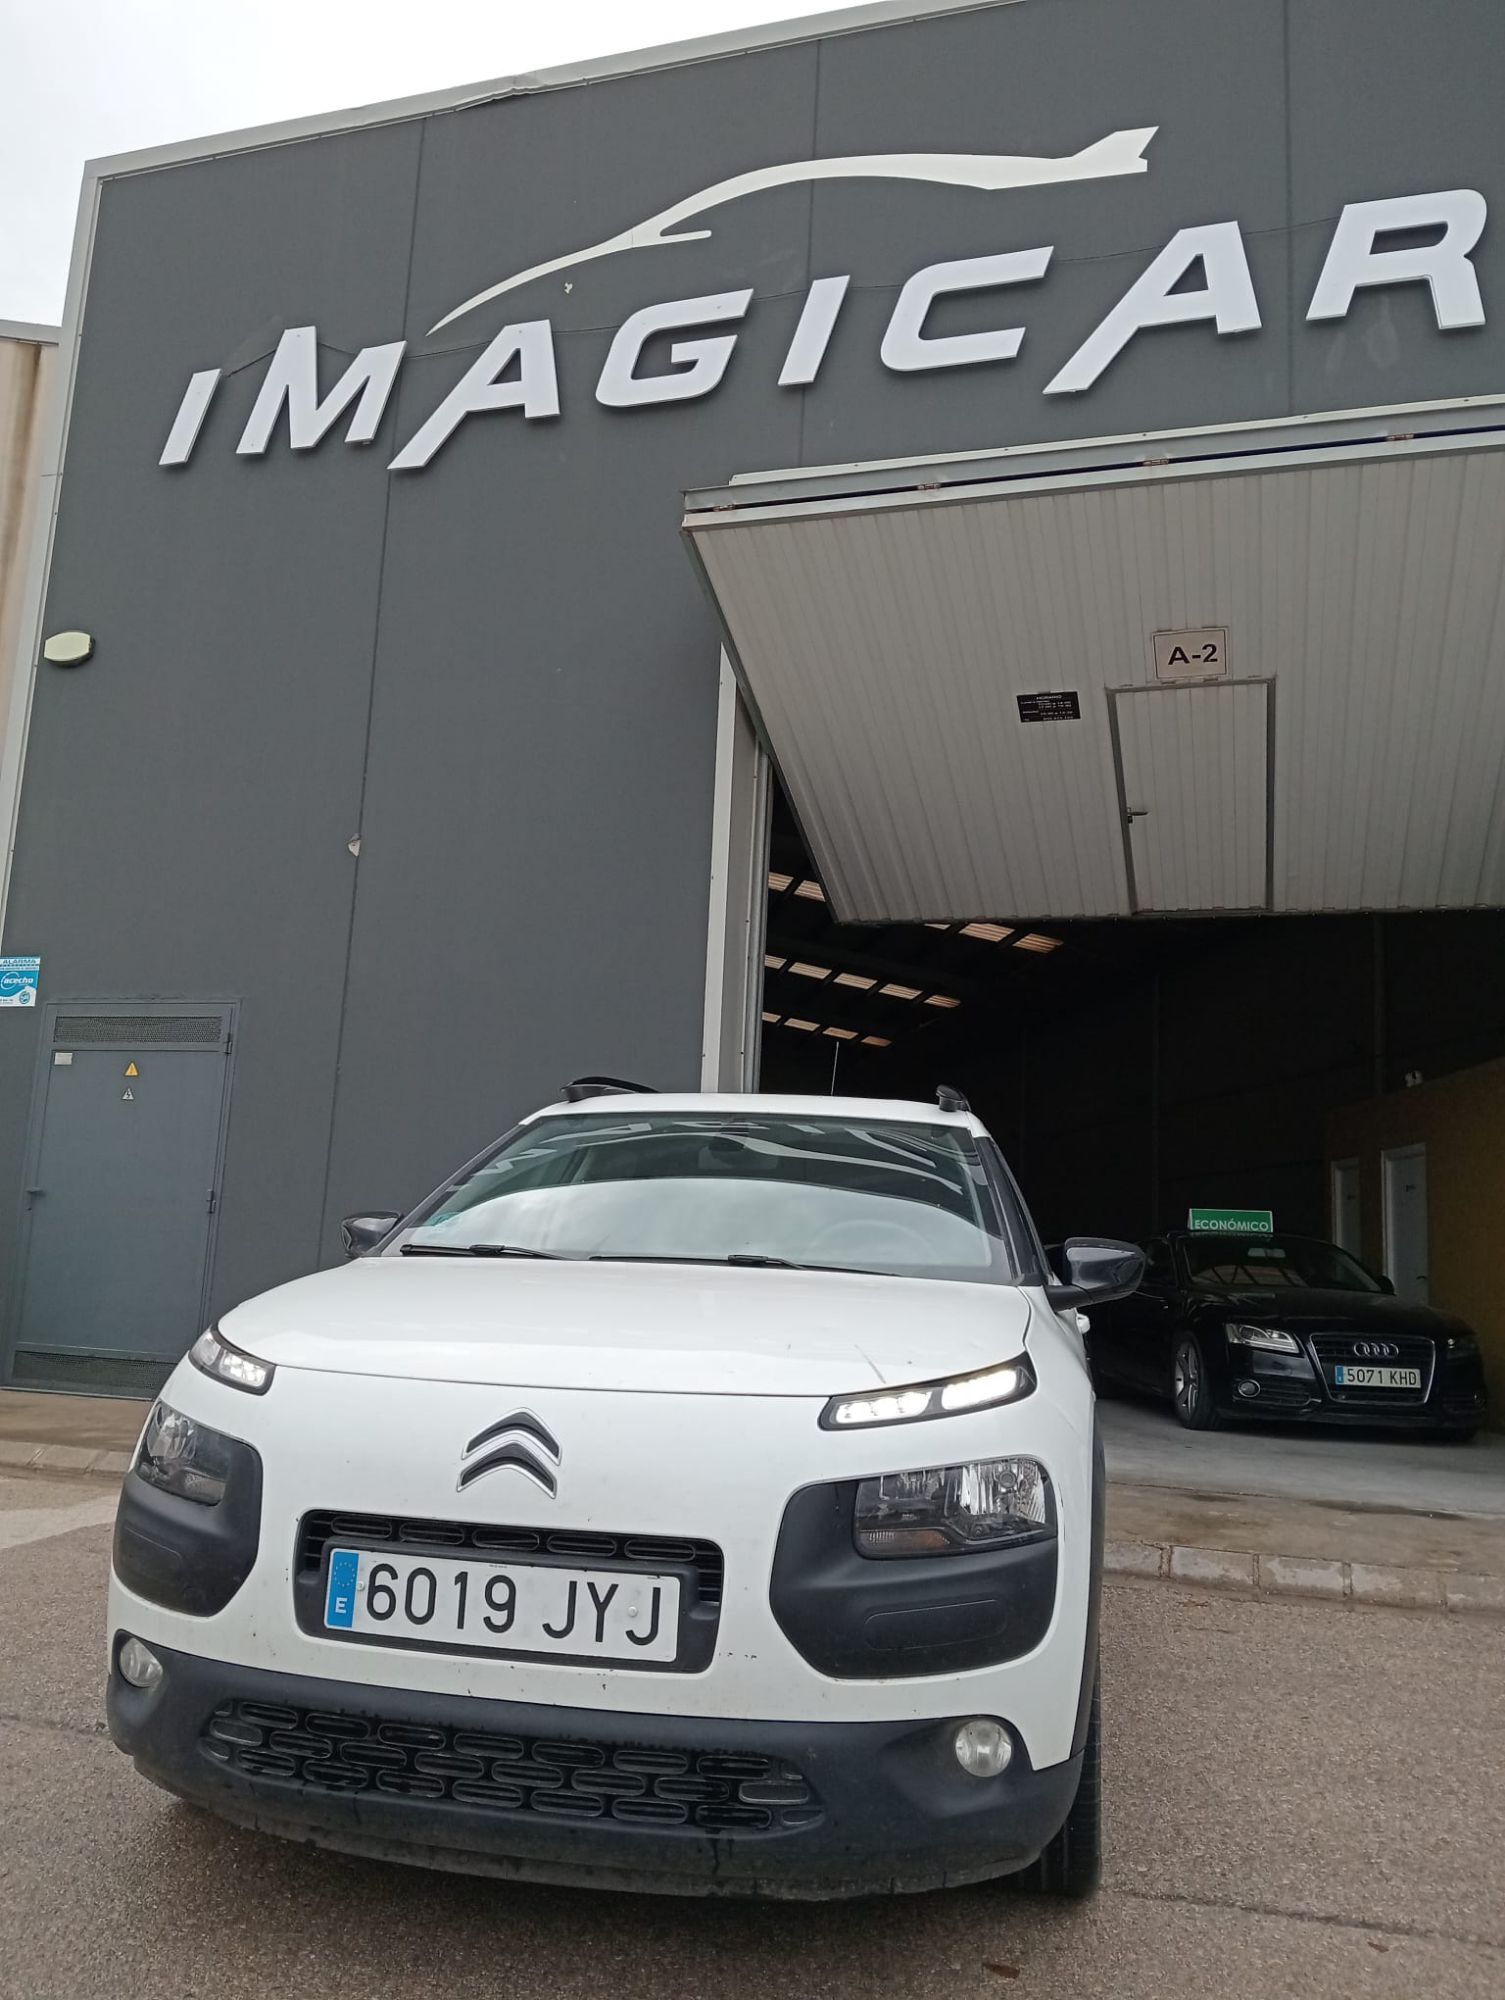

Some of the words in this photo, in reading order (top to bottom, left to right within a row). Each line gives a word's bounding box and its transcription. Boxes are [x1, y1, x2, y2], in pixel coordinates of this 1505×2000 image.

[159, 189, 1488, 470] IMAGICAR
[1168, 644, 1218, 665] A-2
[1194, 1218, 1269, 1231] ECONÓMICO
[1347, 1368, 1383, 1384] 5071
[1389, 1370, 1417, 1385] KHD
[335, 1597, 348, 1614] E
[366, 1563, 517, 1633] 6019
[542, 1580, 661, 1646] JYJ
